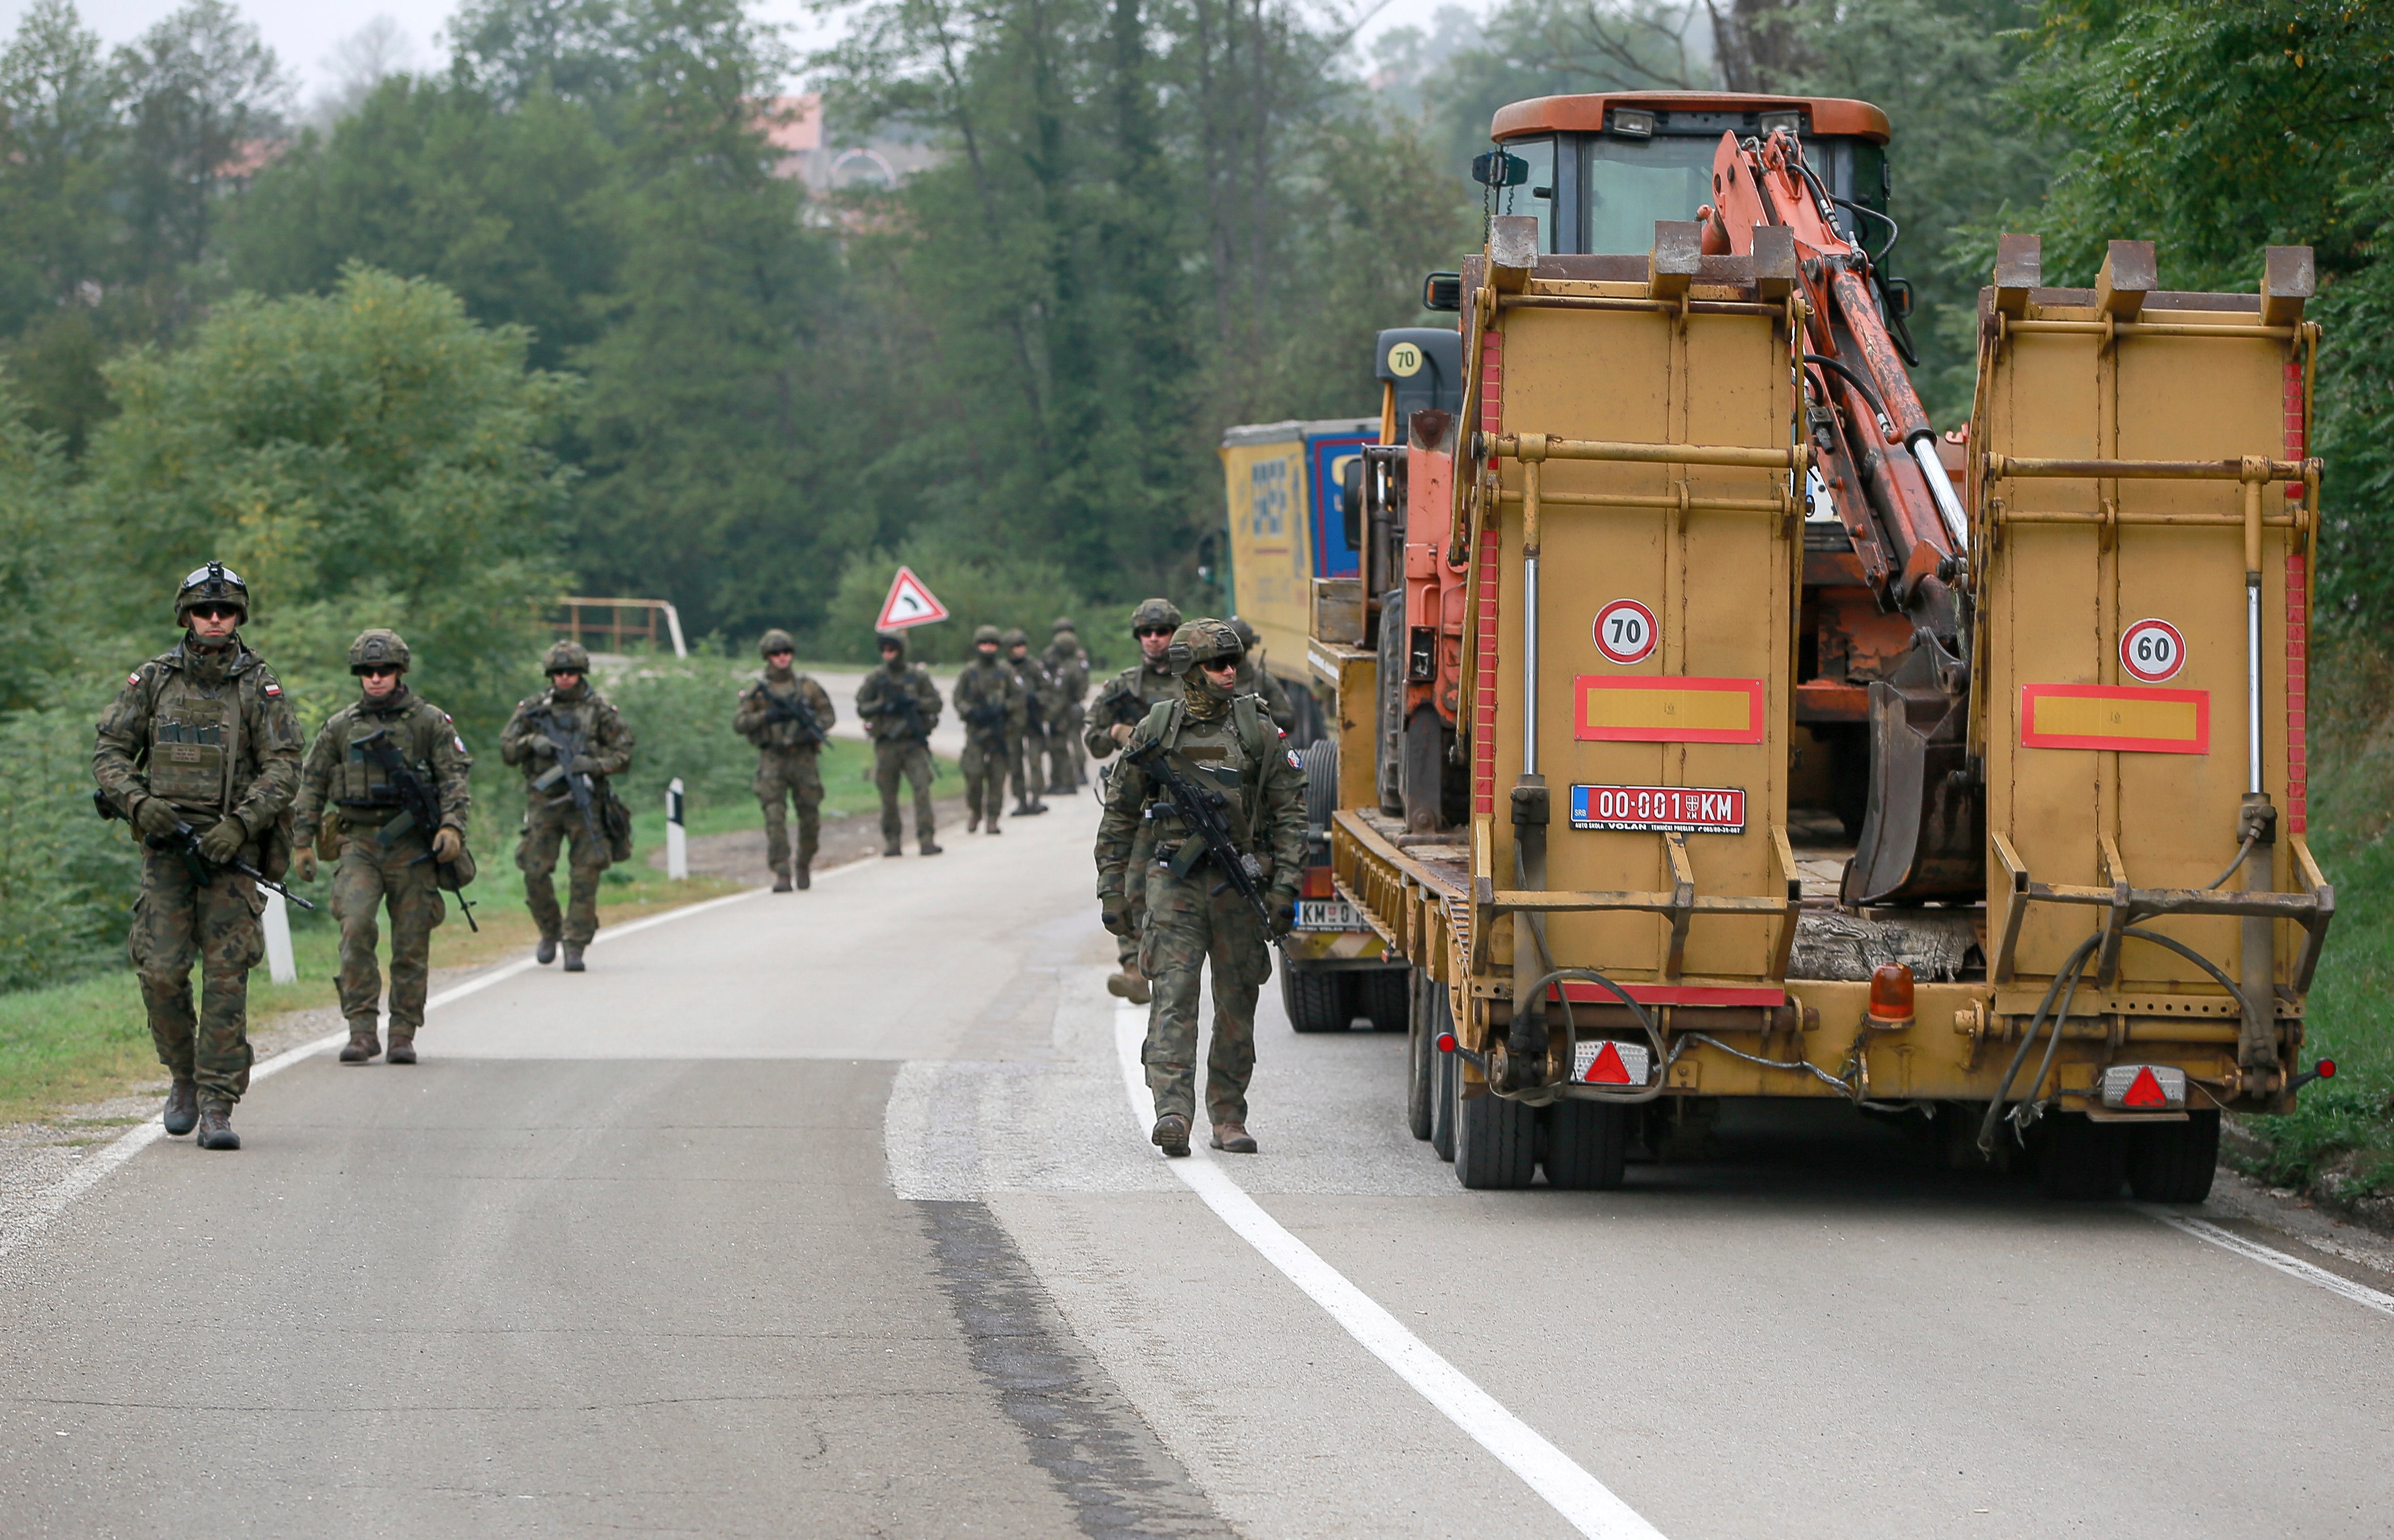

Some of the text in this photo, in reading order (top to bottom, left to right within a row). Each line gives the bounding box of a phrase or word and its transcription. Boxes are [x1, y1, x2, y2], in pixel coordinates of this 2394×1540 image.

[1396, 351, 1415, 368] 70
[1611, 619, 1641, 644] 70
[2137, 636, 2169, 662] 60
[1574, 809, 1586, 817] SRB
[1701, 793, 1732, 821] KM
[1303, 904, 1325, 923] KM
